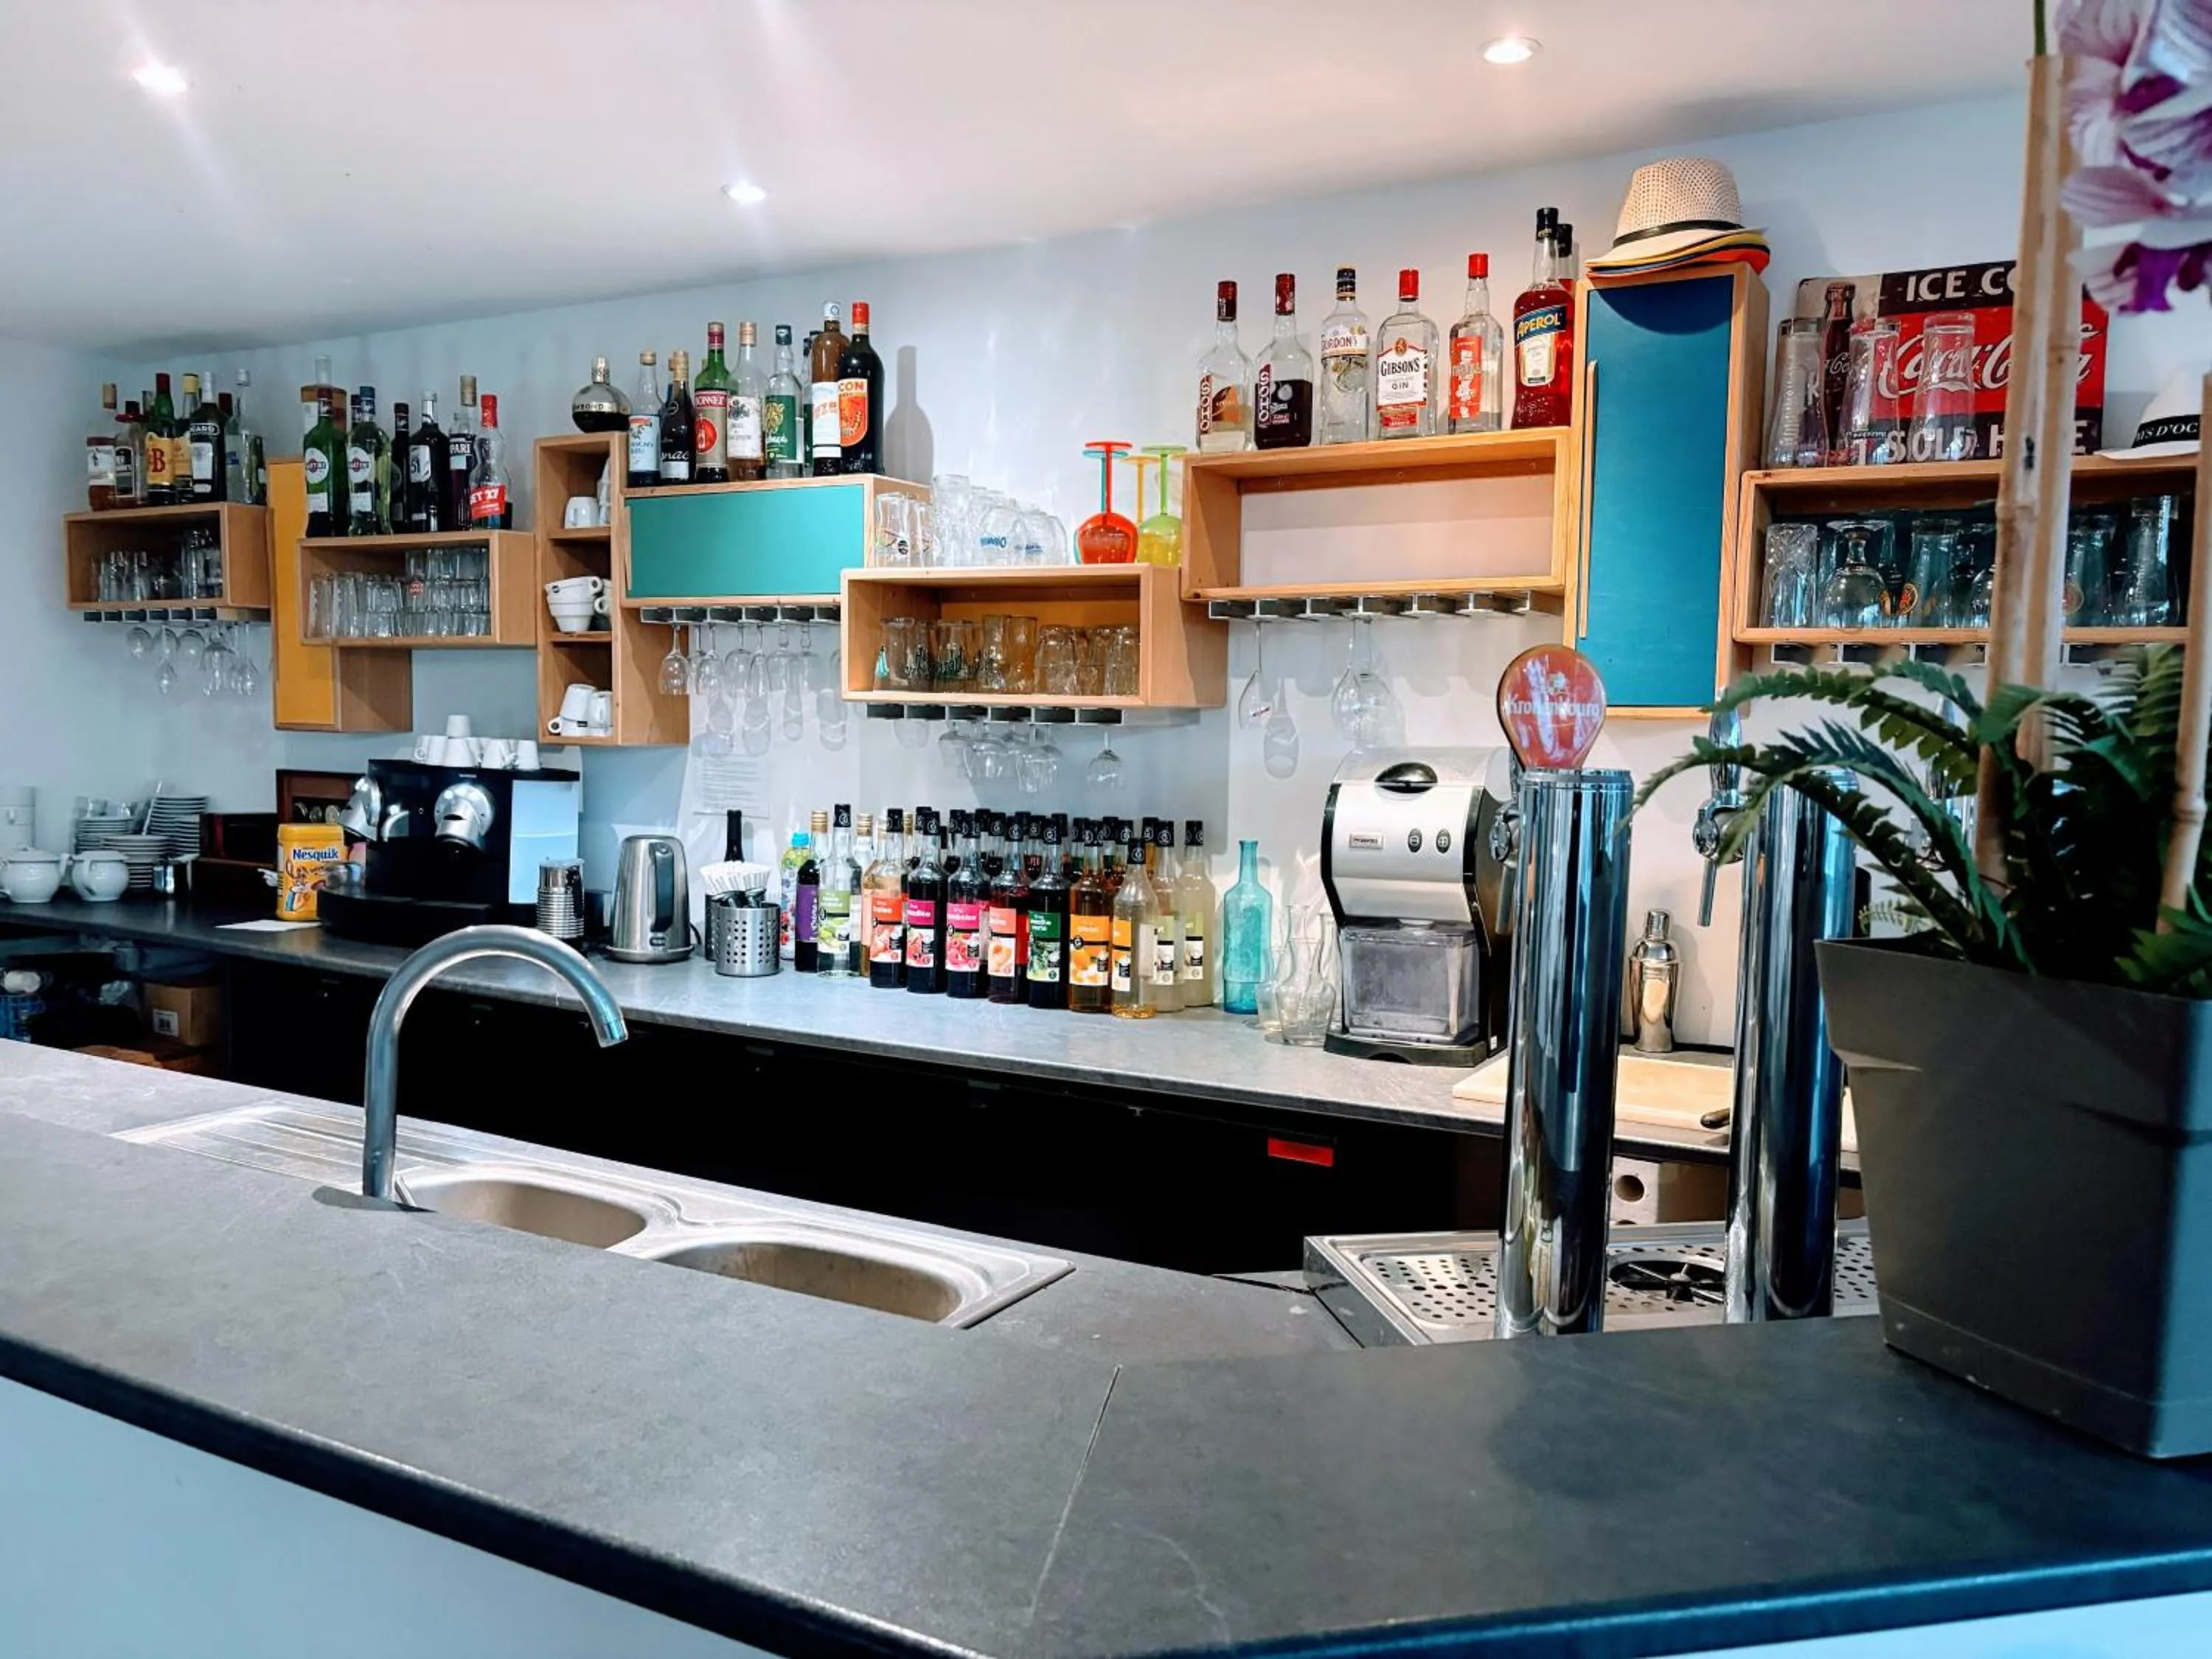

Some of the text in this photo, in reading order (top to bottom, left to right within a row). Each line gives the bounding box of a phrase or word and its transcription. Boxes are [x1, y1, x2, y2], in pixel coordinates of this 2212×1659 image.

[1906, 271, 1966, 302] ICE
[1517, 312, 1561, 340] APEROL
[1259, 372, 1270, 422] SOHO
[1391, 382, 1409, 391] GIN
[1200, 383, 1210, 431] SOHO
[449, 442, 471, 454] PARI
[1886, 426, 1978, 464] SOLD
[293, 847, 338, 861] Nesquik
